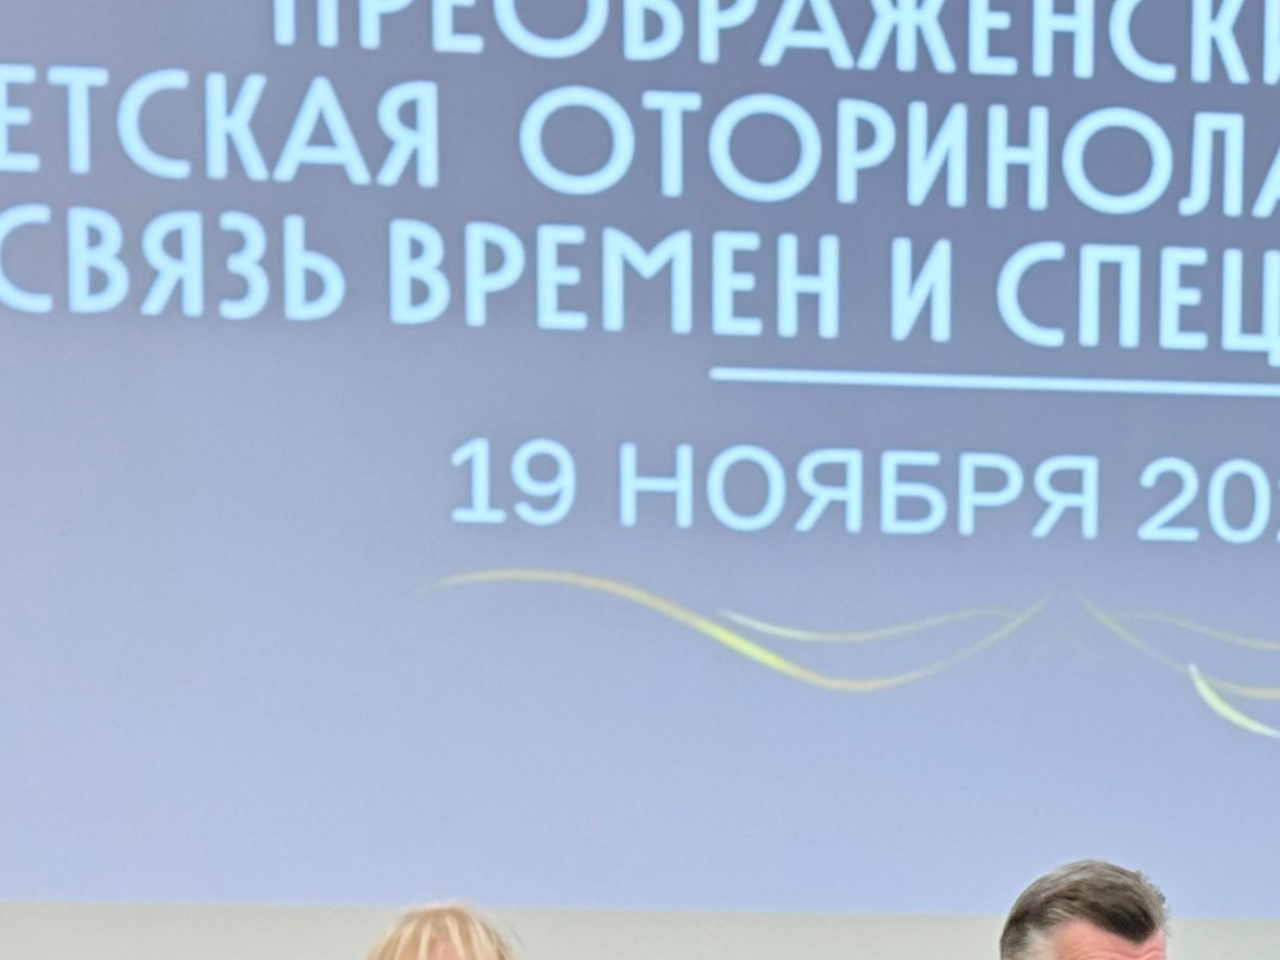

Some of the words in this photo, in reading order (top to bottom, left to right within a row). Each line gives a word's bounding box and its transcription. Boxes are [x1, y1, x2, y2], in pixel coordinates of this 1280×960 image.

[0, 64, 440, 188] ЕТСКАЯ
[0, 203, 347, 321] СВЯЗЬ
[389, 218, 841, 339] ВРЕМЕН
[891, 237, 953, 343] И
[450, 437, 577, 527] 19
[619, 442, 1100, 540] НОЯБРЯ
